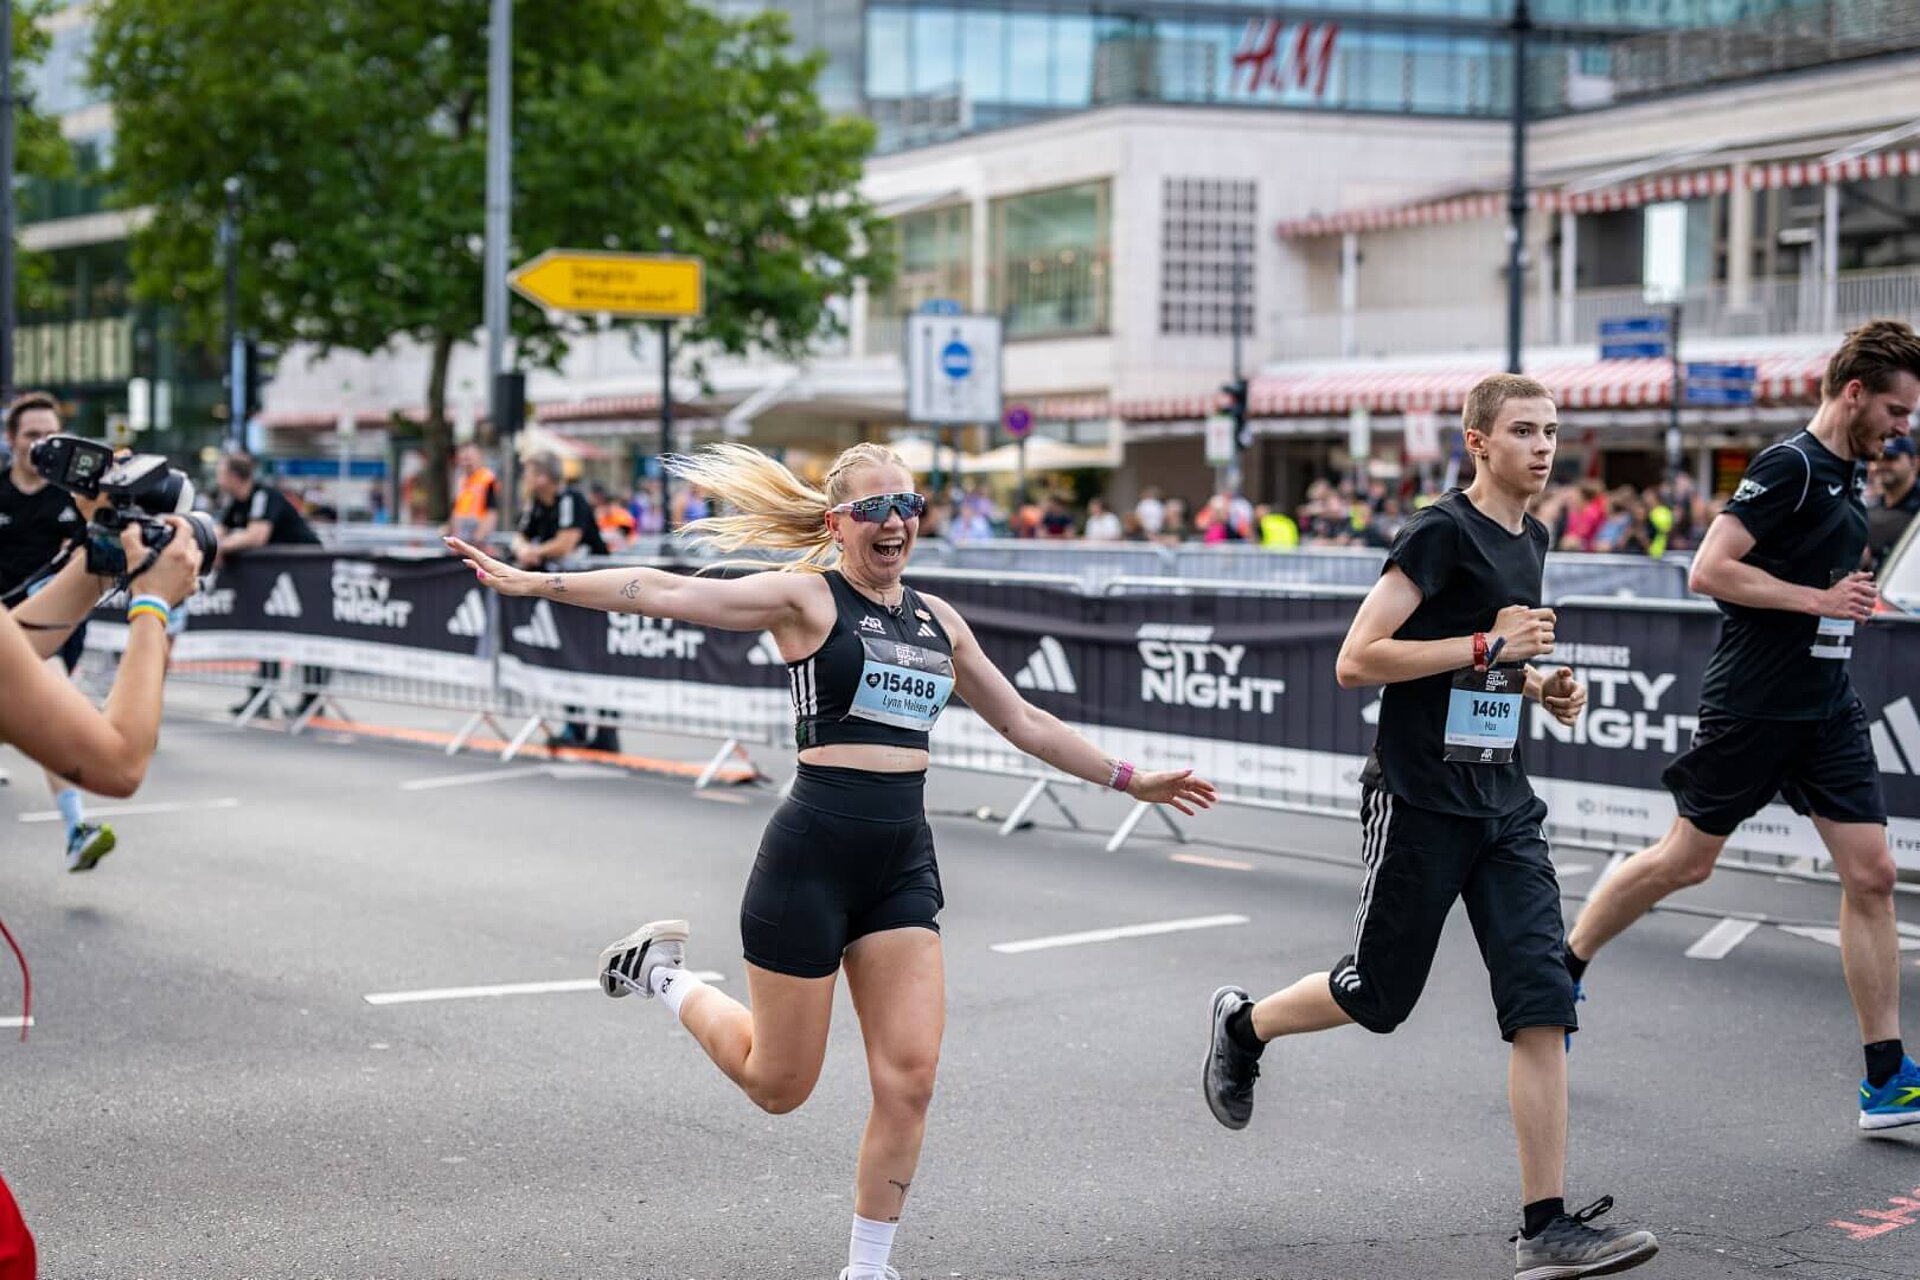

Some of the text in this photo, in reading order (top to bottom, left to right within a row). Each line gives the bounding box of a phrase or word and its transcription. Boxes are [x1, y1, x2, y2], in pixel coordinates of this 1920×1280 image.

[332, 597, 414, 629] NIGHT
[606, 626, 706, 660] NIGHT
[1138, 639, 1246, 677] CITY
[882, 671, 936, 700] 15488
[1141, 667, 1285, 714] NIGHT
[1472, 699, 1511, 719] 14619
